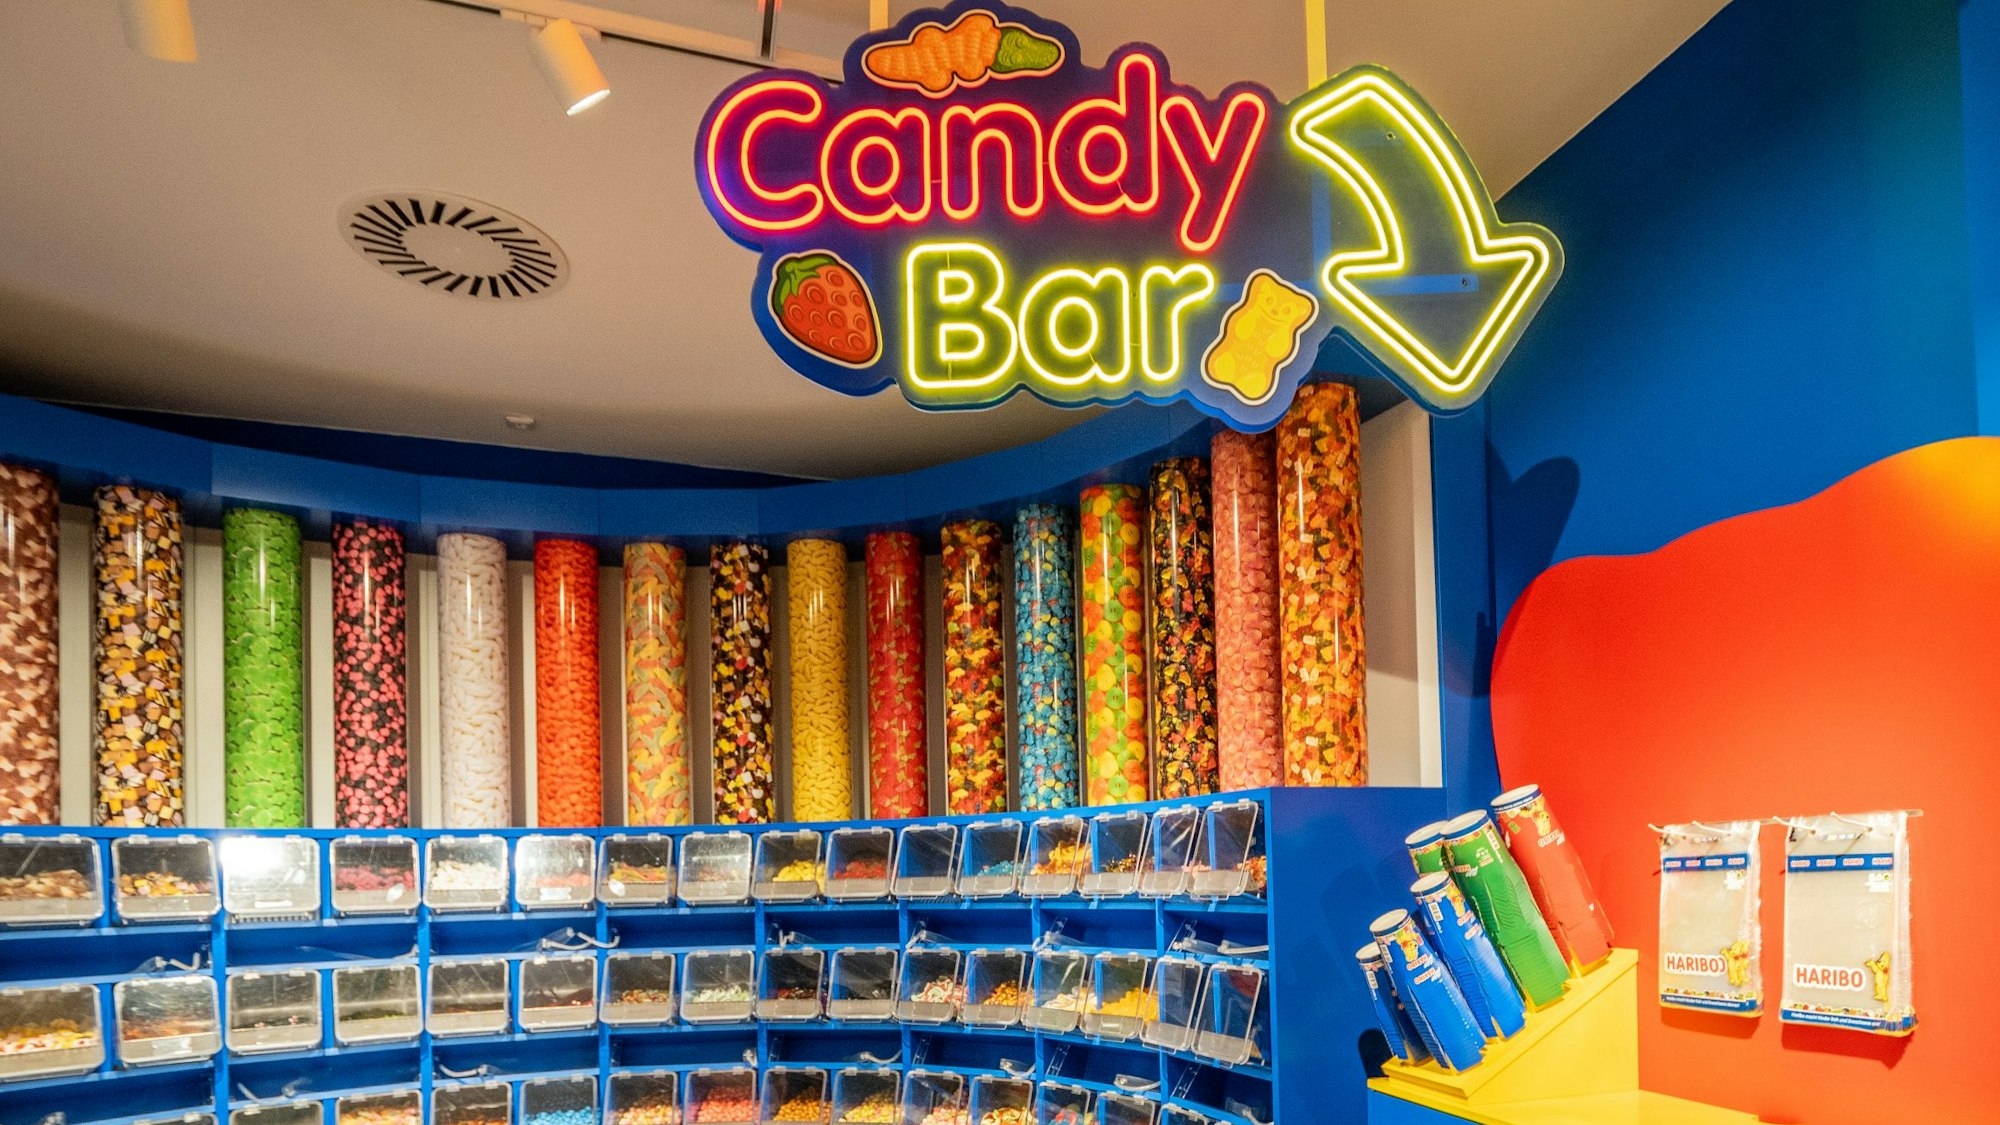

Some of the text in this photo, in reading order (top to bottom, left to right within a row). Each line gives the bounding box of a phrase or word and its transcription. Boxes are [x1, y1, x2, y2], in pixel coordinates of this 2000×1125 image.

[706, 53, 1267, 252] Candy
[904, 241, 1215, 391] Bar
[1666, 955, 1719, 973] HARIBO
[1796, 967, 1863, 988] HARIBO
